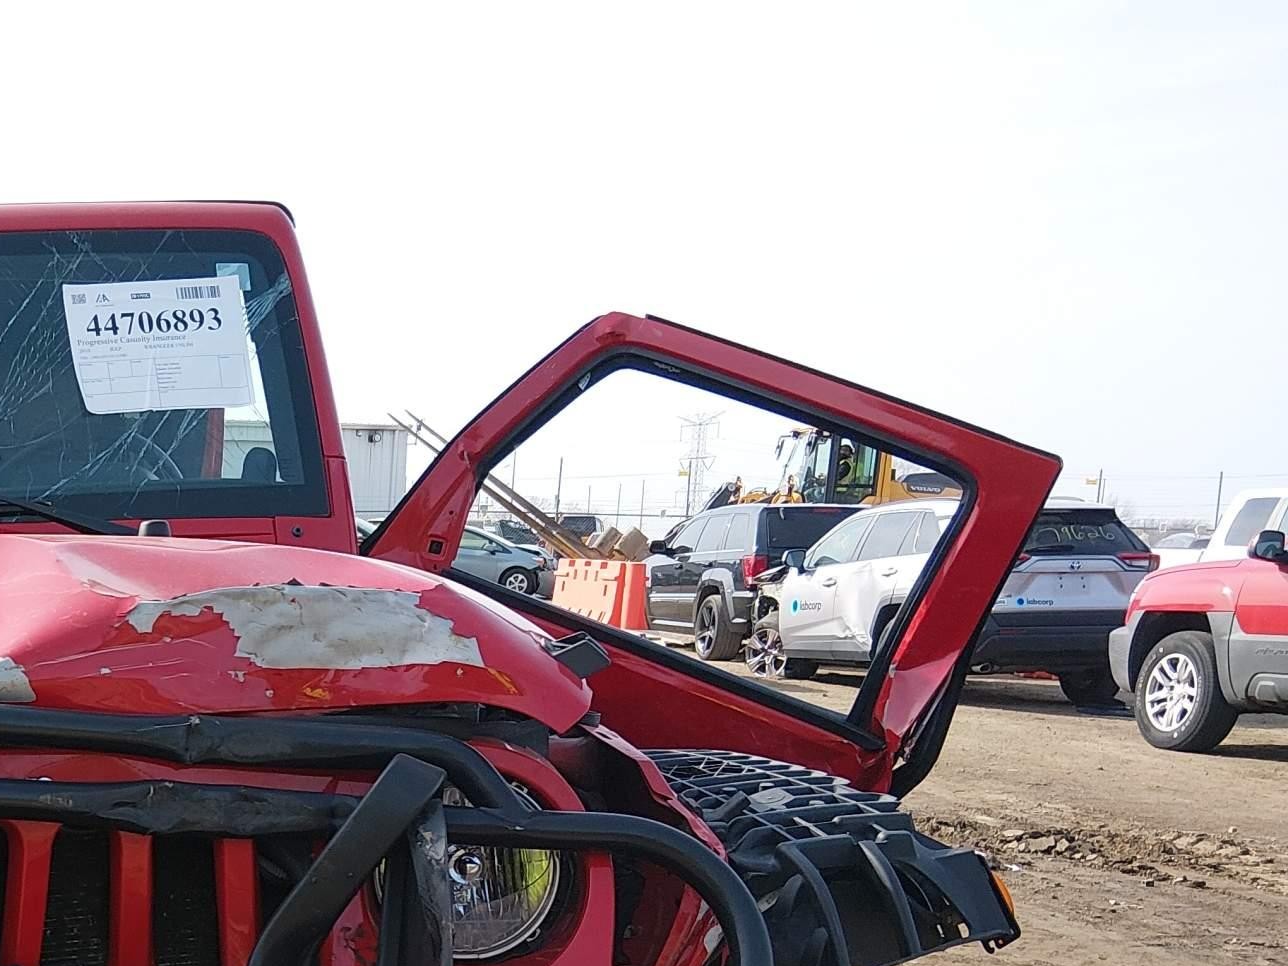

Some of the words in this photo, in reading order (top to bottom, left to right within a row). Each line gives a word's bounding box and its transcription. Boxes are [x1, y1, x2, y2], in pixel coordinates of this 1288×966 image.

[86, 307, 223, 337] 44706893
[77, 336, 118, 347] Progressive
[800, 599, 822, 612] labcorp
[1027, 597, 1054, 606] labcorp
